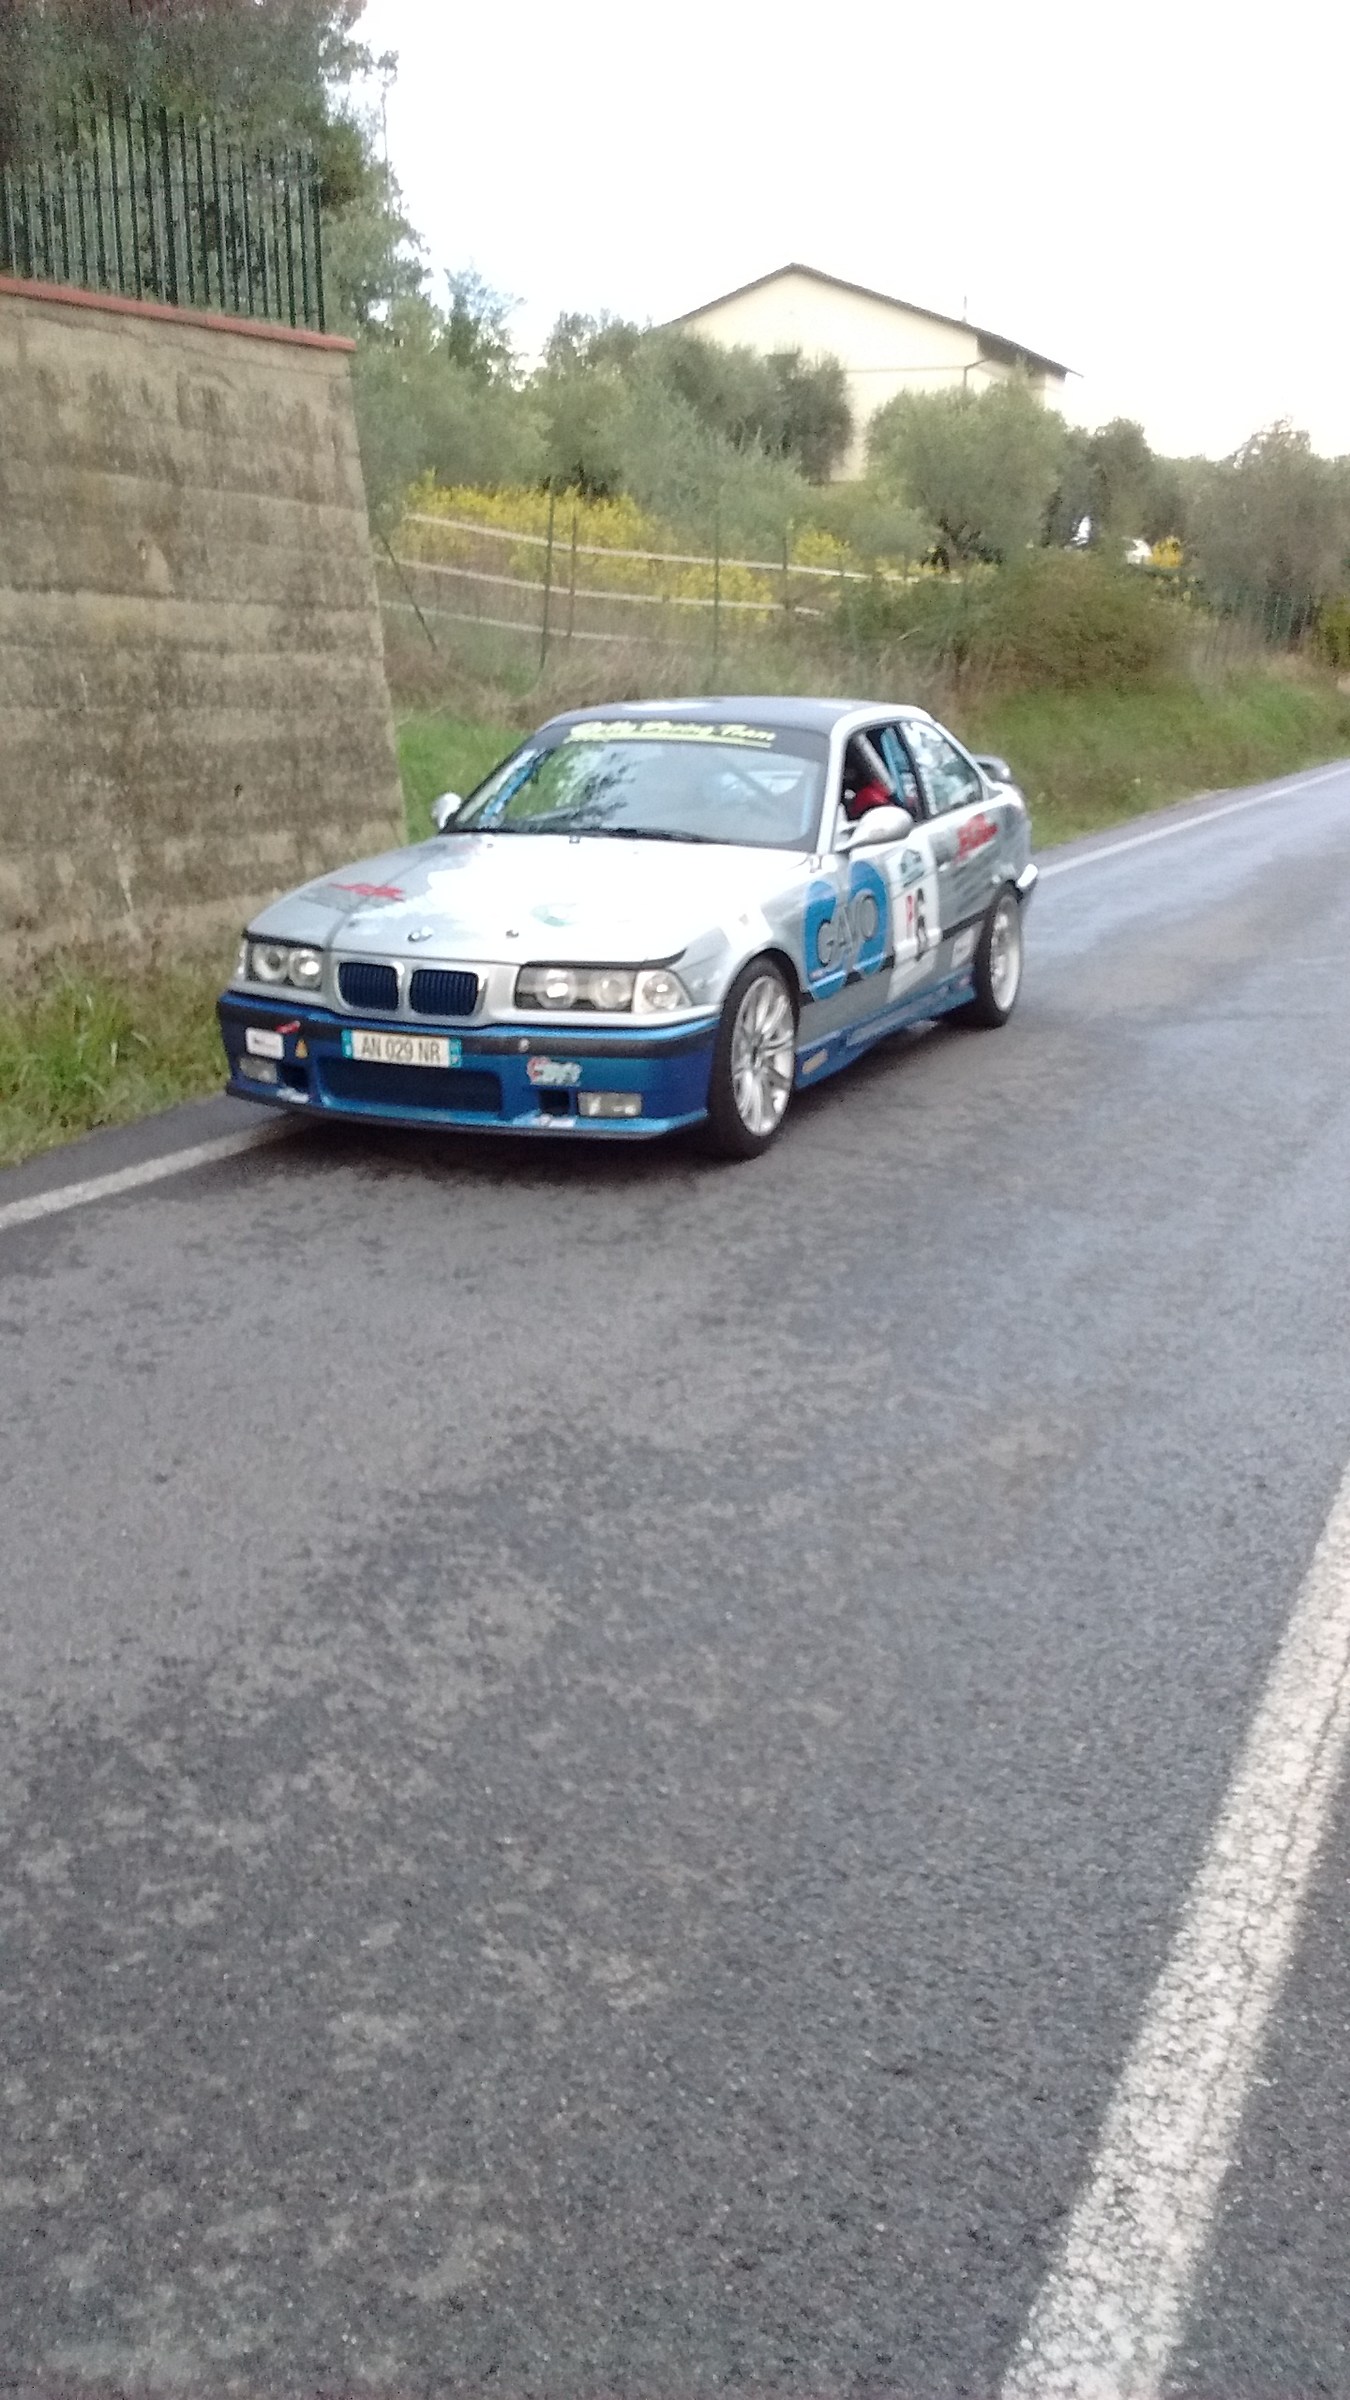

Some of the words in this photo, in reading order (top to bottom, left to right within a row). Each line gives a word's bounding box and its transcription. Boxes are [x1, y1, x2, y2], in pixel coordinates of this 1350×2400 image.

[361, 1036, 382, 1057] AN
[384, 1038, 414, 1061] 029
[418, 1041, 441, 1064] NR
